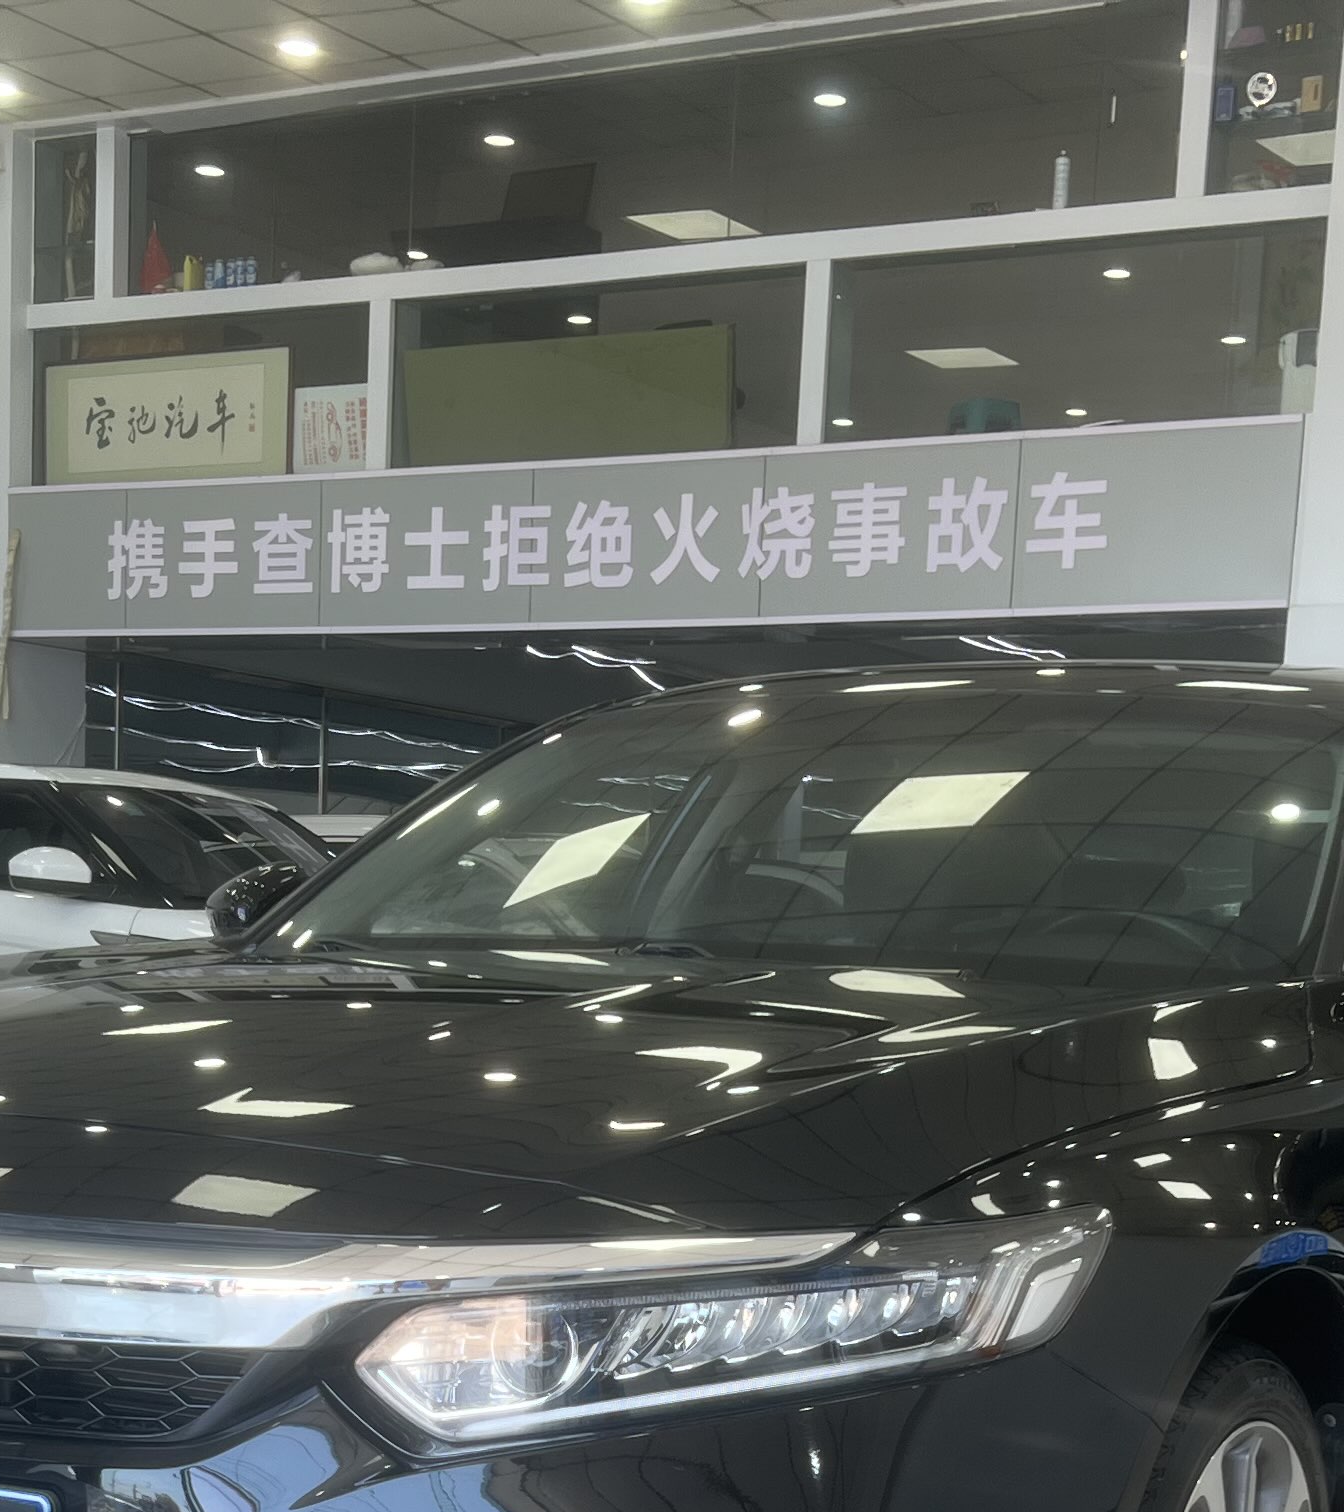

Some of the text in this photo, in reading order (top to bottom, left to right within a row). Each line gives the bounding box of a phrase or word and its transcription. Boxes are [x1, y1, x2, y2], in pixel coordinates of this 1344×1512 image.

[106, 472, 1108, 600] 携手查博士拒绝火烧事故车
